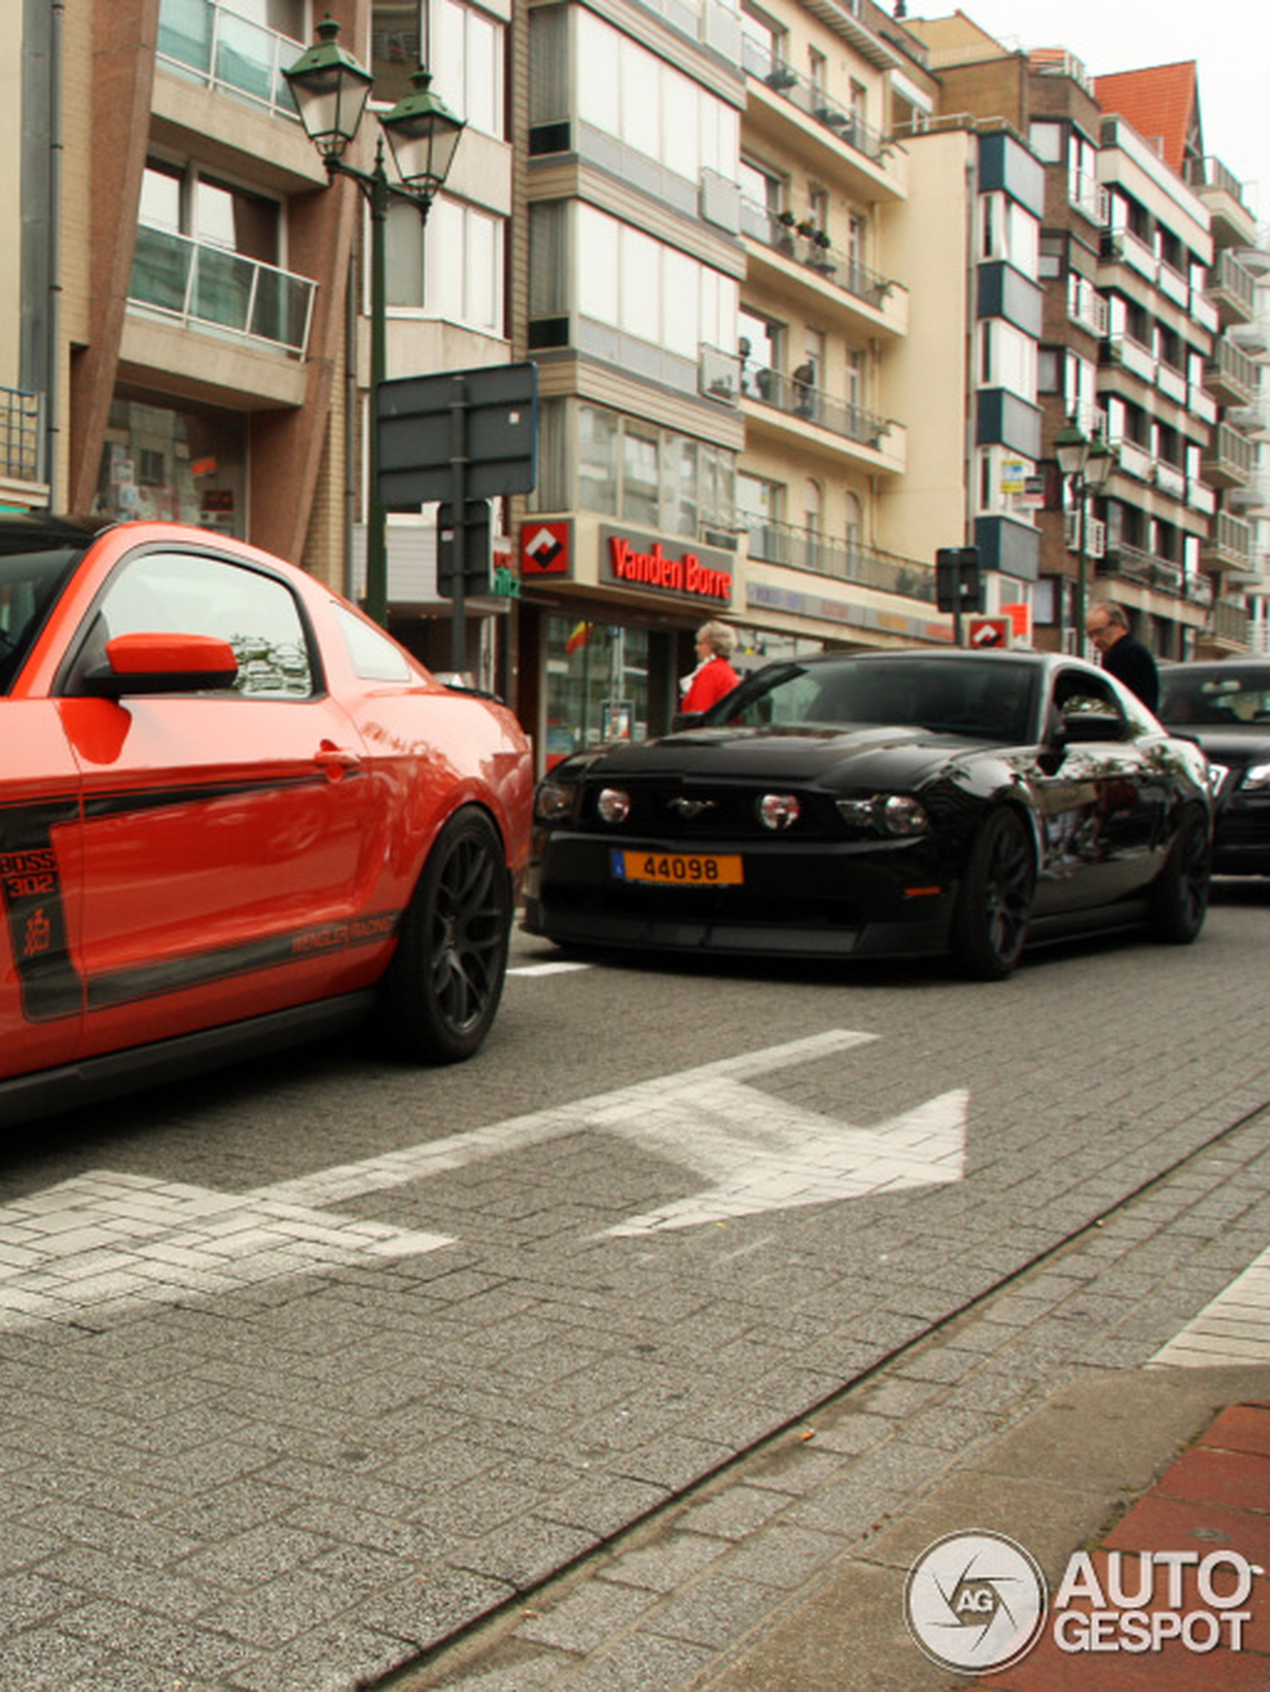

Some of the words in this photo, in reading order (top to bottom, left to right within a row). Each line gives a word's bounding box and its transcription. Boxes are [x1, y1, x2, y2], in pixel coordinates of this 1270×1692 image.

[608, 535, 683, 590] Vanden
[681, 552, 732, 600] Borre
[0, 851, 57, 876] BOSS
[644, 856, 718, 880] 44098
[7, 874, 55, 898] 302
